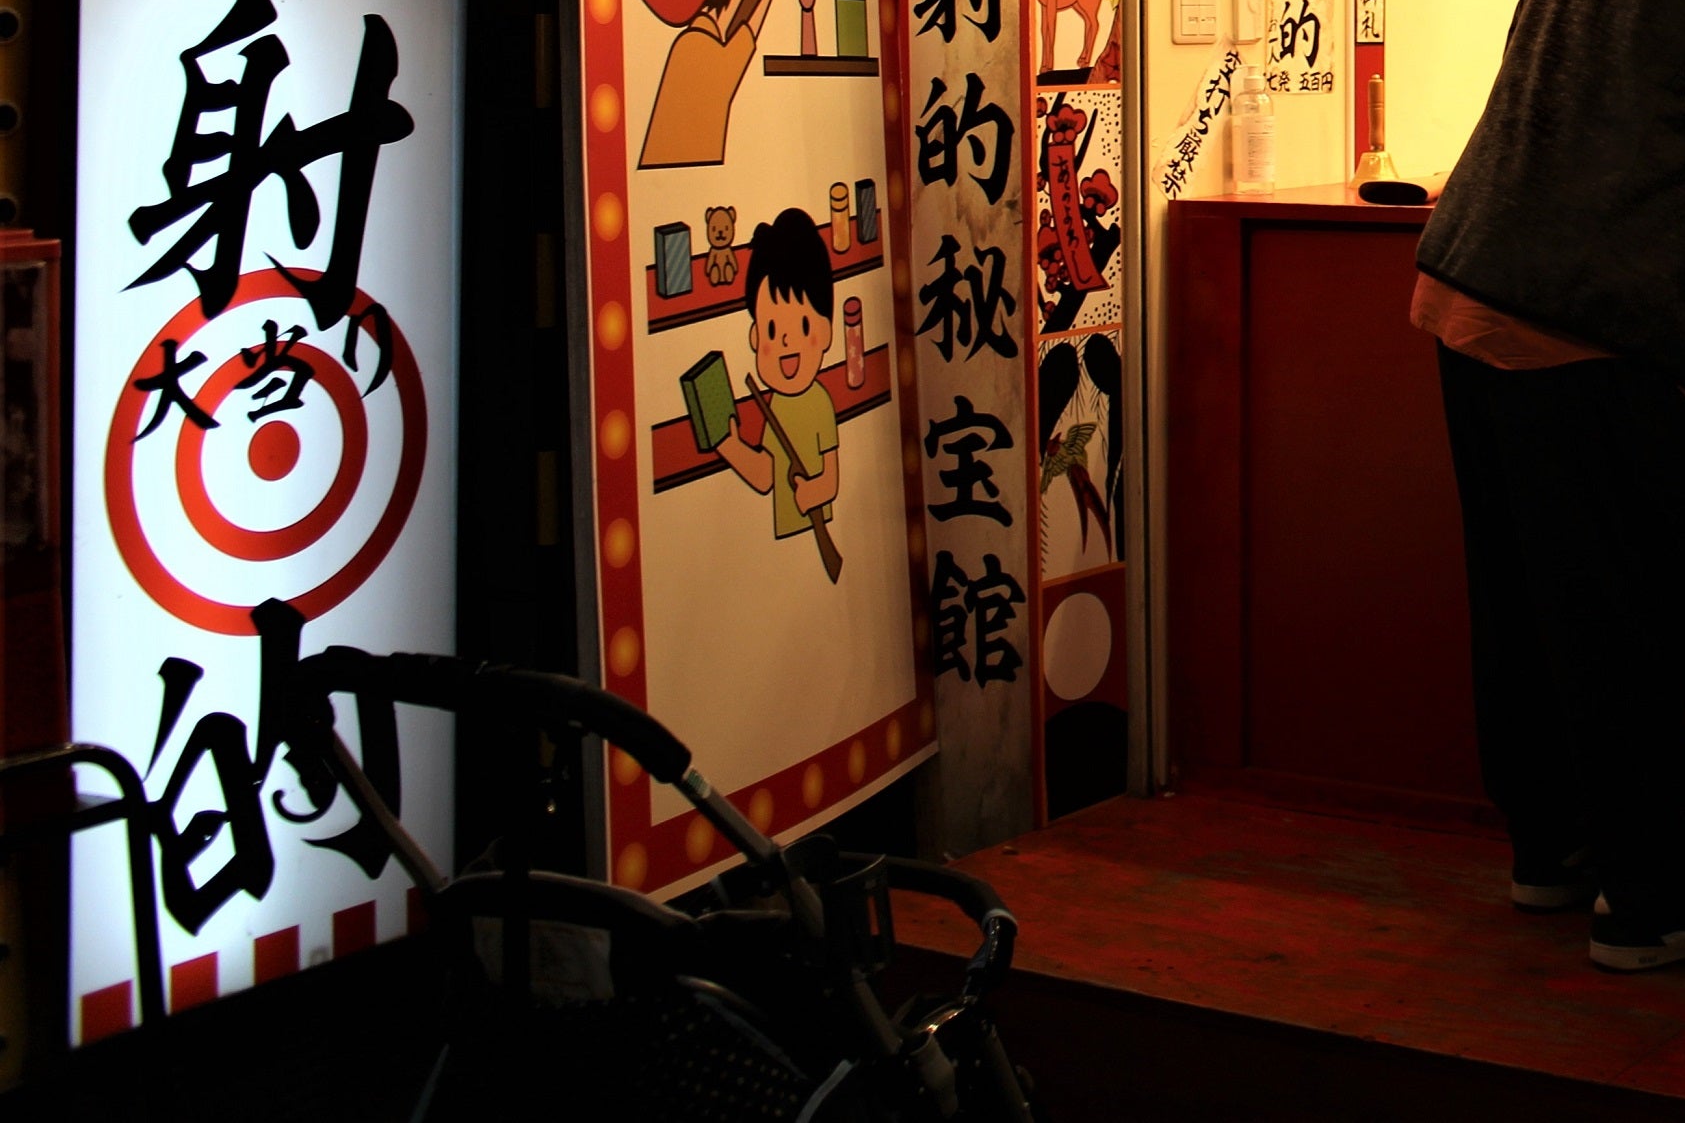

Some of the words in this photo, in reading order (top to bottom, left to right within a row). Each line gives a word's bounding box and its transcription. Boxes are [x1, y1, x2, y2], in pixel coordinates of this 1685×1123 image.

[1299, 71, 1334, 93] 五百円
[131, 302, 396, 443] 大当り
